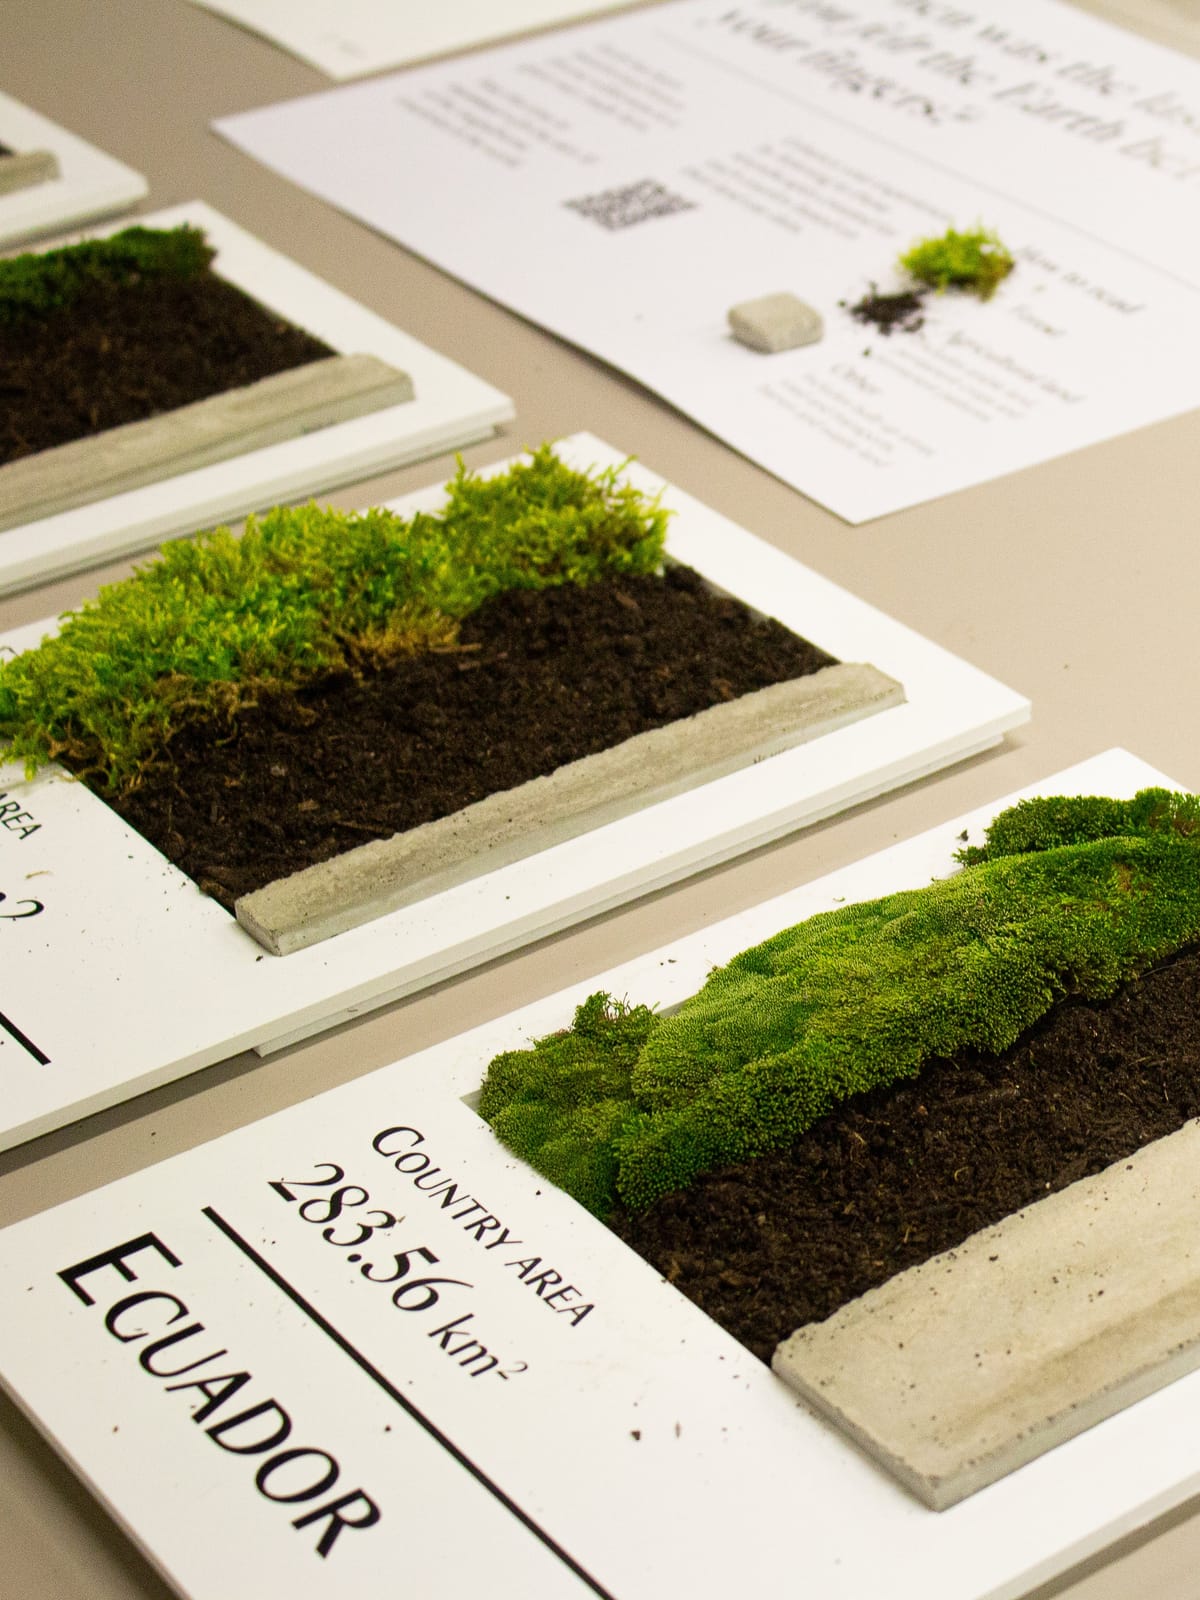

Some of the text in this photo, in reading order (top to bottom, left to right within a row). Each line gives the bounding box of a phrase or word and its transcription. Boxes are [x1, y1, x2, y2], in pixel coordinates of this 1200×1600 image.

[0, 792, 42, 840] REA
[267, 1163, 474, 1311] 283.56
[372, 1126, 595, 1327] COUNTRY AREA
[57, 1232, 381, 1559] ECUADOR
